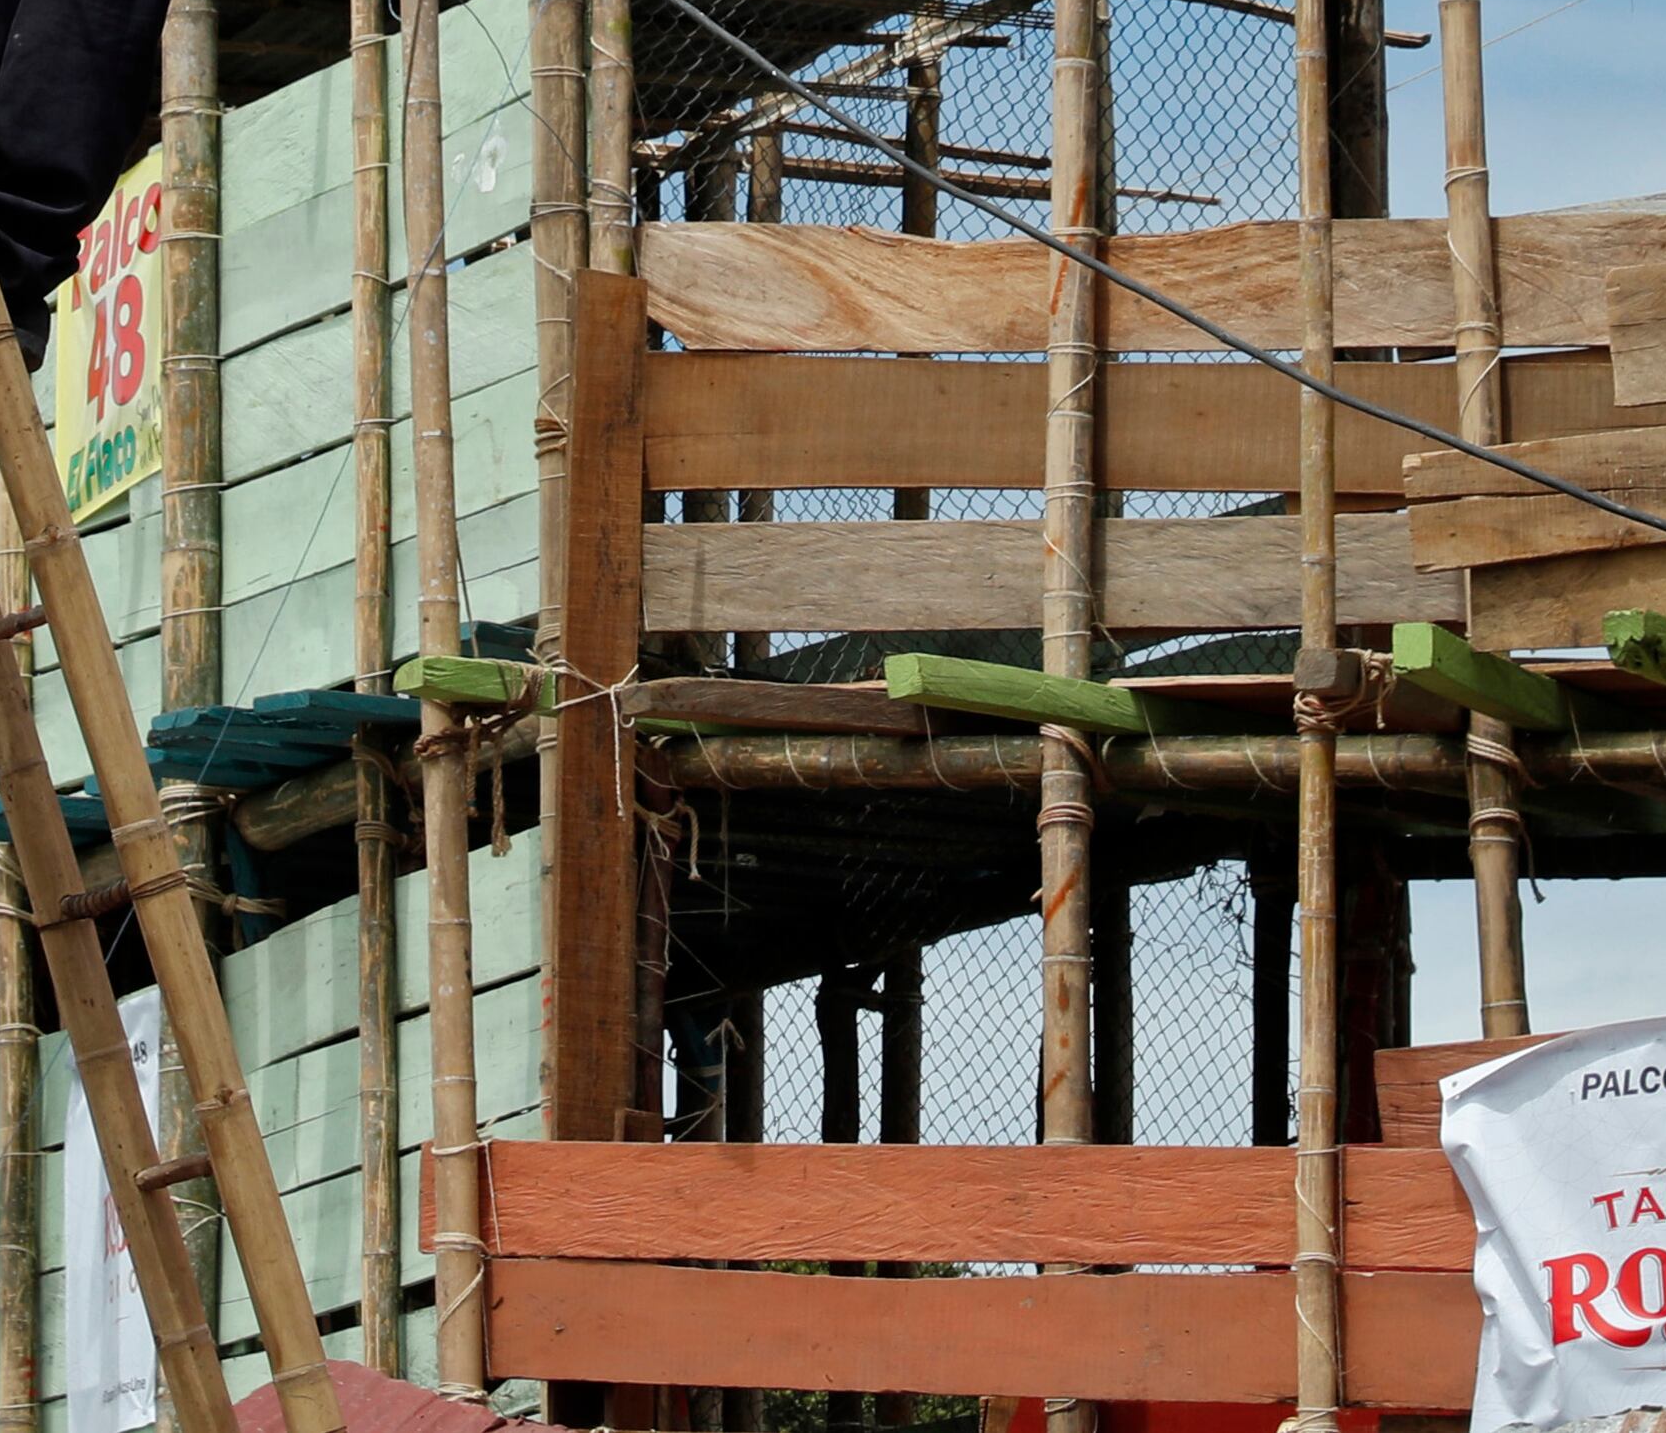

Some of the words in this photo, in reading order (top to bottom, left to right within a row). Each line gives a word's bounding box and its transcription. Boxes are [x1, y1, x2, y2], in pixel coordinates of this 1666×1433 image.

[72, 182, 161, 311] Palco
[88, 274, 145, 423] 48
[67, 446, 85, 512] El
[85, 424, 136, 503] Flaco
[133, 1040, 148, 1067] 48
